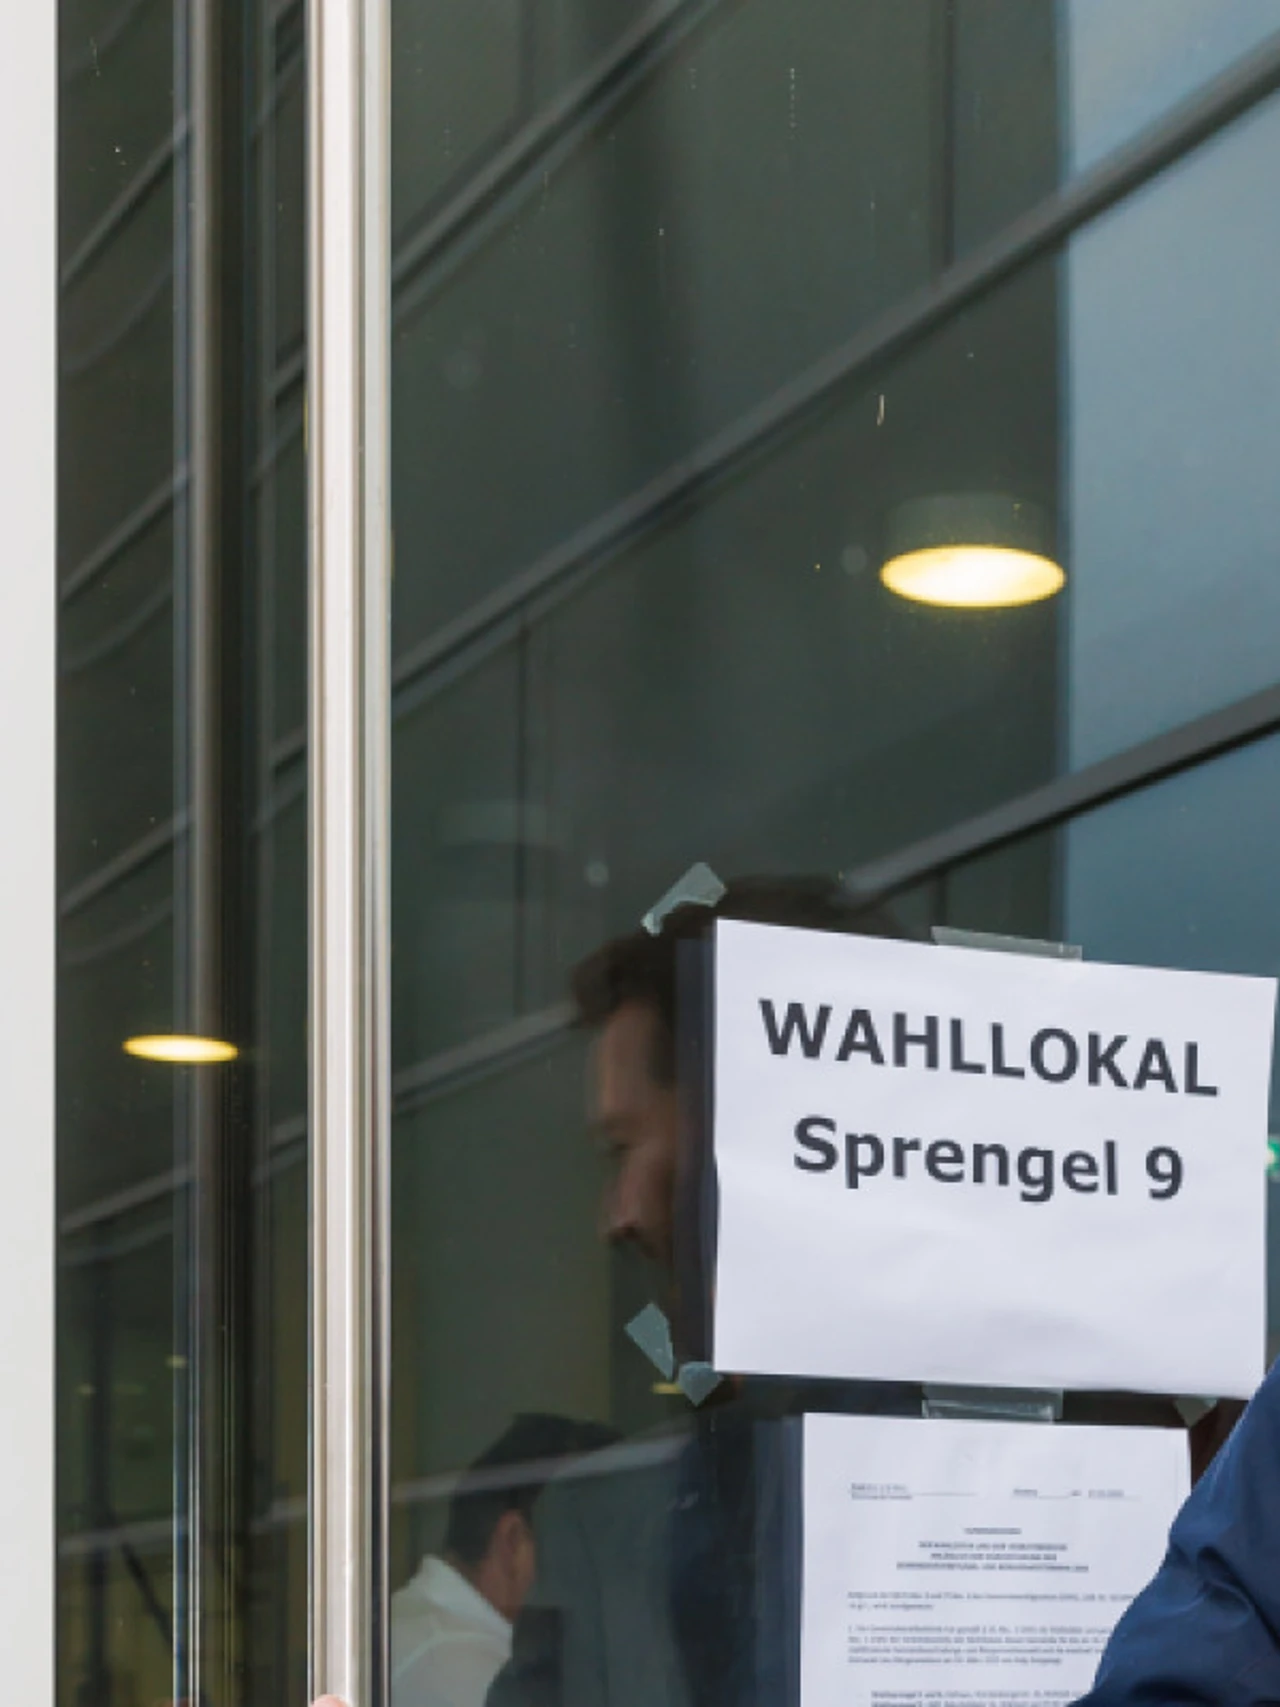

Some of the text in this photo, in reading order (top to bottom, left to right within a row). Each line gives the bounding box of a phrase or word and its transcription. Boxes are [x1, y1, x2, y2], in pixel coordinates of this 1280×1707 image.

[758, 998, 1219, 1097] WAHLLOKAL
[793, 1115, 1184, 1203] Sprengel 9
